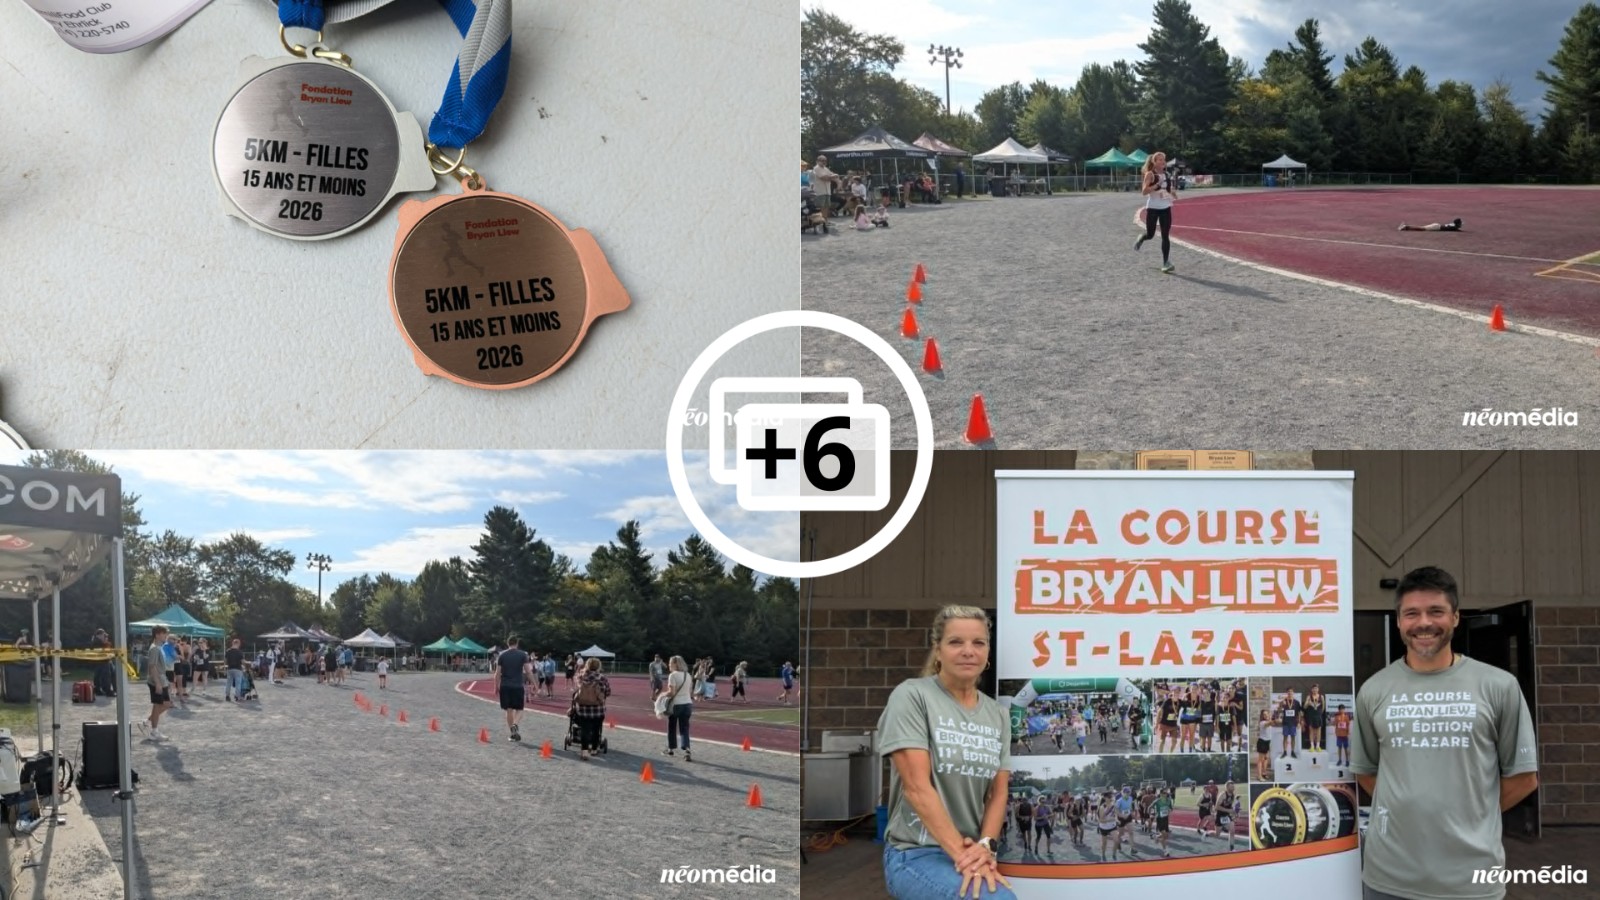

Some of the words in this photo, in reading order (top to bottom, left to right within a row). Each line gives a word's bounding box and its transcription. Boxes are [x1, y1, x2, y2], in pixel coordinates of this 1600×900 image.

[86, 2, 112, 15] Club
[78, 21, 130, 37] 220-5740
[302, 83, 353, 96] Fondation
[301, 93, 328, 104] Bryan
[330, 96, 352, 106] Liew
[244, 138, 288, 163] 5KM
[306, 143, 369, 171] FILLES
[243, 169, 260, 187] 15
[263, 171, 294, 190] ANS
[297, 174, 316, 192] ET
[318, 176, 366, 197] MOINS
[278, 199, 323, 221] 2026
[465, 218, 518, 230] Fondation
[467, 231, 496, 240] Bryan
[497, 228, 520, 236] Liew
[425, 286, 470, 313] 5KM
[488, 277, 555, 307] FILLES
[430, 322, 450, 342] 15
[454, 318, 485, 340] ANS
[488, 316, 506, 336] ET
[510, 311, 561, 334] MOINS
[476, 344, 524, 370] 2026
[1034, 510, 1098, 544] LA
[1120, 509, 1320, 546] COURSE
[1031, 569, 1194, 606] BRYAN
[1209, 569, 1322, 606] LIEW
[1032, 630, 1325, 668] ST-LAZARE
[1392, 693, 1408, 703] LA
[1414, 691, 1472, 702] COURSE
[1390, 706, 1434, 716] BRYAN
[1438, 705, 1470, 716] LIEW
[939, 716, 956, 728] LA
[940, 731, 978, 747] BRYAN
[1391, 736, 1470, 748] ST-LAZARE
[962, 749, 1000, 766] ÉDITIO
[938, 763, 996, 778] ST-LAZAR
